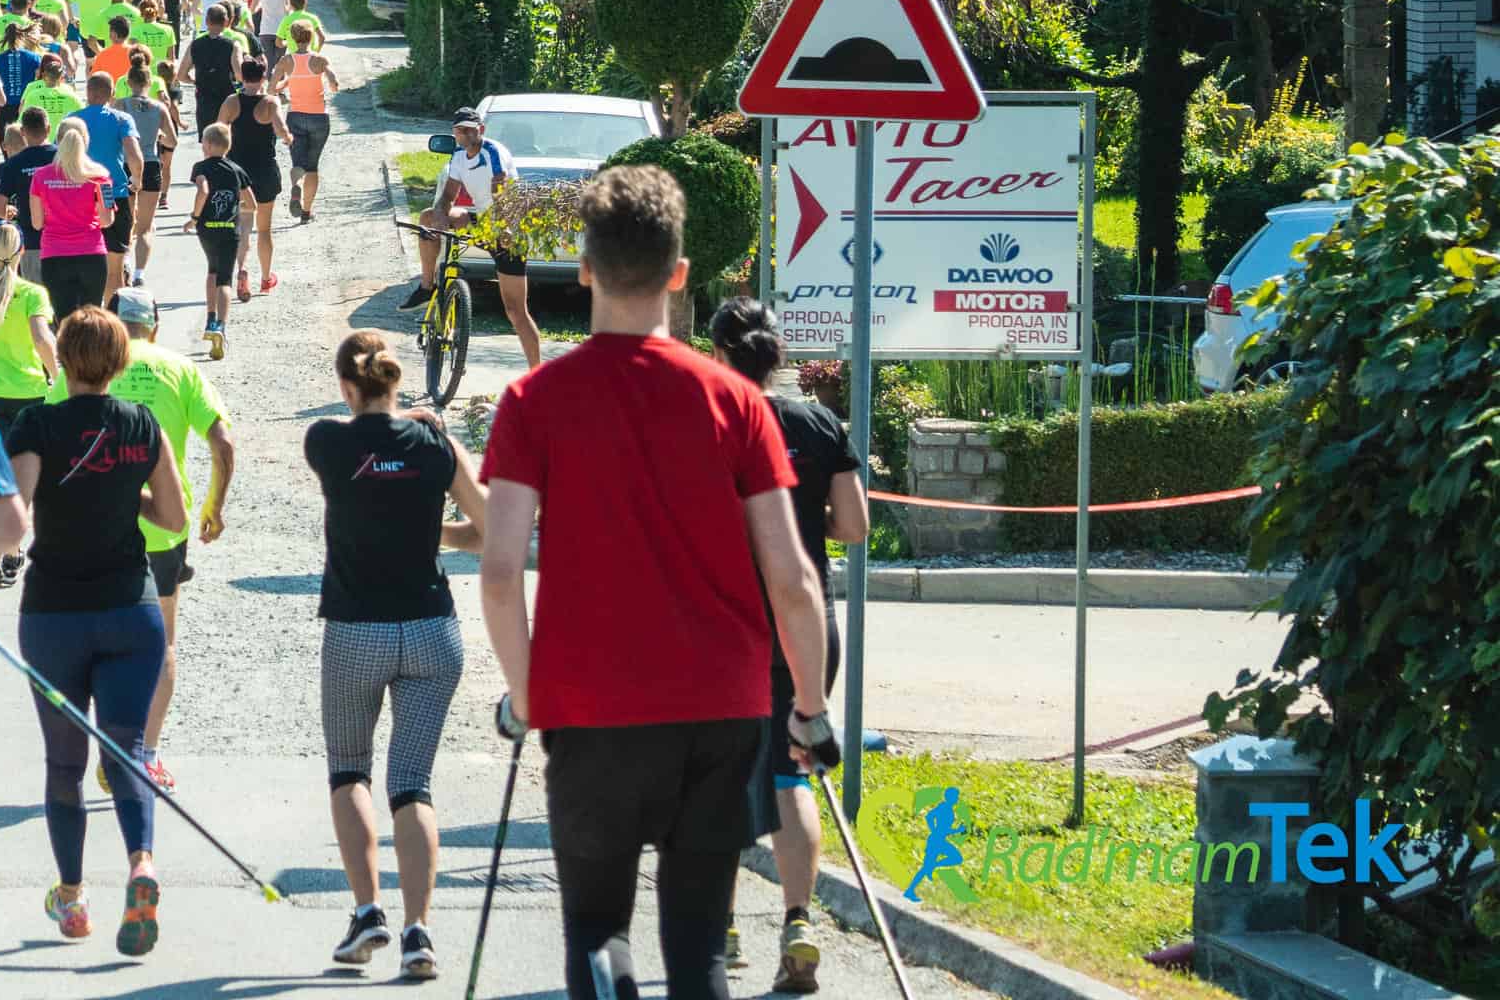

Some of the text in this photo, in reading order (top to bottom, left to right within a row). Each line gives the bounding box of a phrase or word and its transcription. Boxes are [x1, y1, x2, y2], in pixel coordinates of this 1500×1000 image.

[885, 157, 1064, 207] Tacer
[947, 268, 1053, 284] DAEWOO
[787, 284, 917, 304] proon
[955, 293, 1046, 310] MOTOR
[783, 311, 853, 325] PRODAJ
[968, 315, 1068, 328] PRODAJA IN
[783, 328, 845, 342] SERVIS
[1006, 330, 1068, 344] SERVIS
